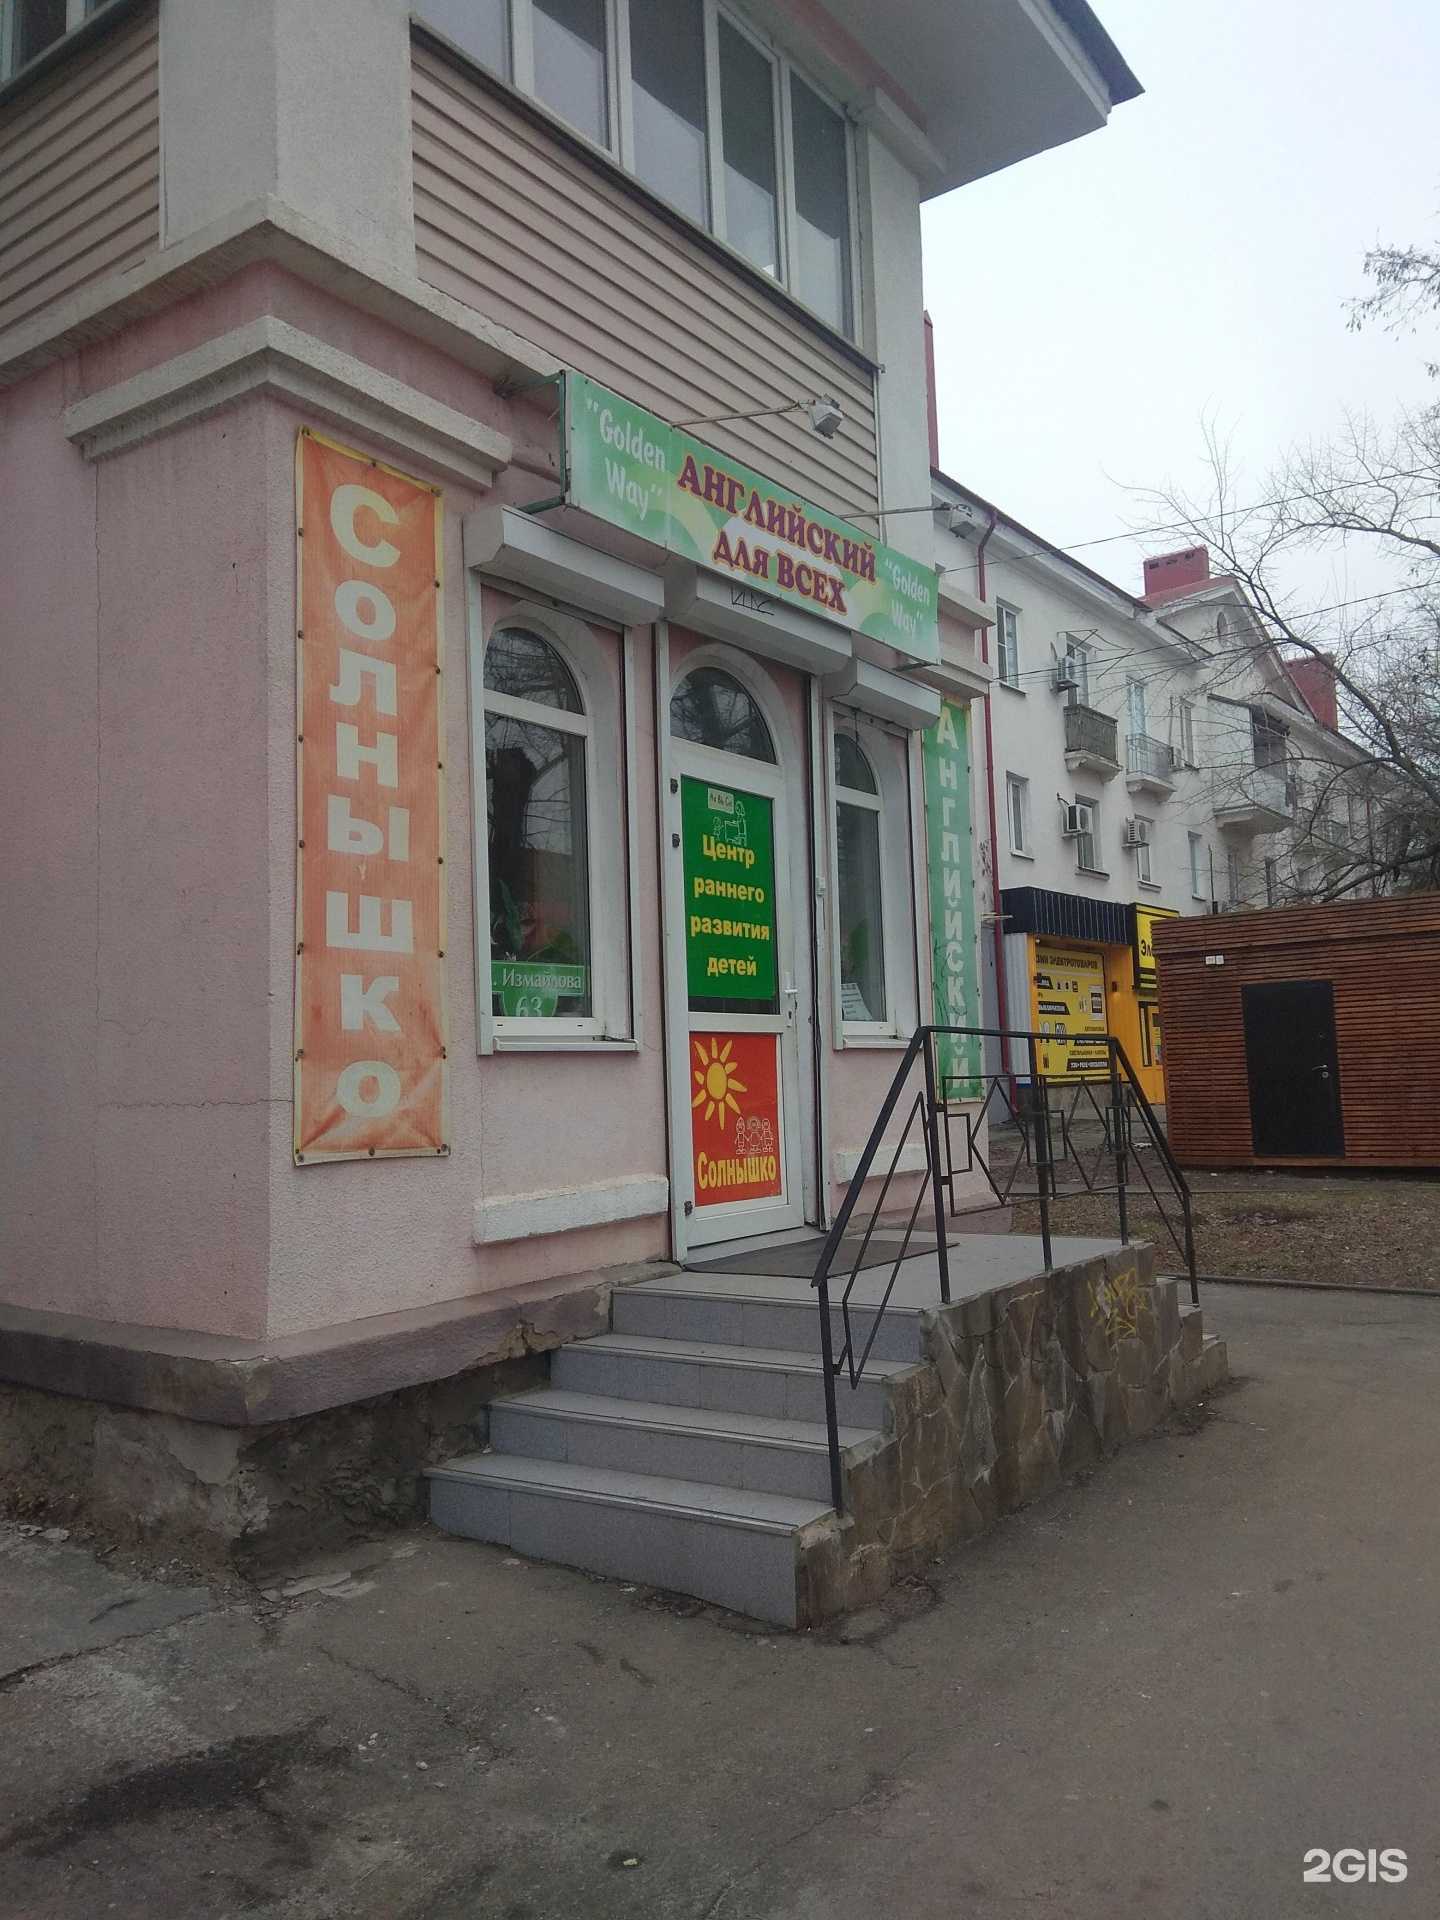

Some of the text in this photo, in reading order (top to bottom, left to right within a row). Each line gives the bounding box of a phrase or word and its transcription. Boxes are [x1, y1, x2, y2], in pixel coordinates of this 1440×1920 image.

[678, 454, 877, 583] АНГЛИЙСКИЙ
[712, 529, 770, 580] ДЛЯ
[777, 551, 848, 617] ВСЕХ
[702, 833, 756, 869] Центр
[693, 876, 765, 903] раннего
[690, 915, 770, 941] развития
[706, 954, 757, 977] детей
[697, 1151, 777, 1190] Солнышко
